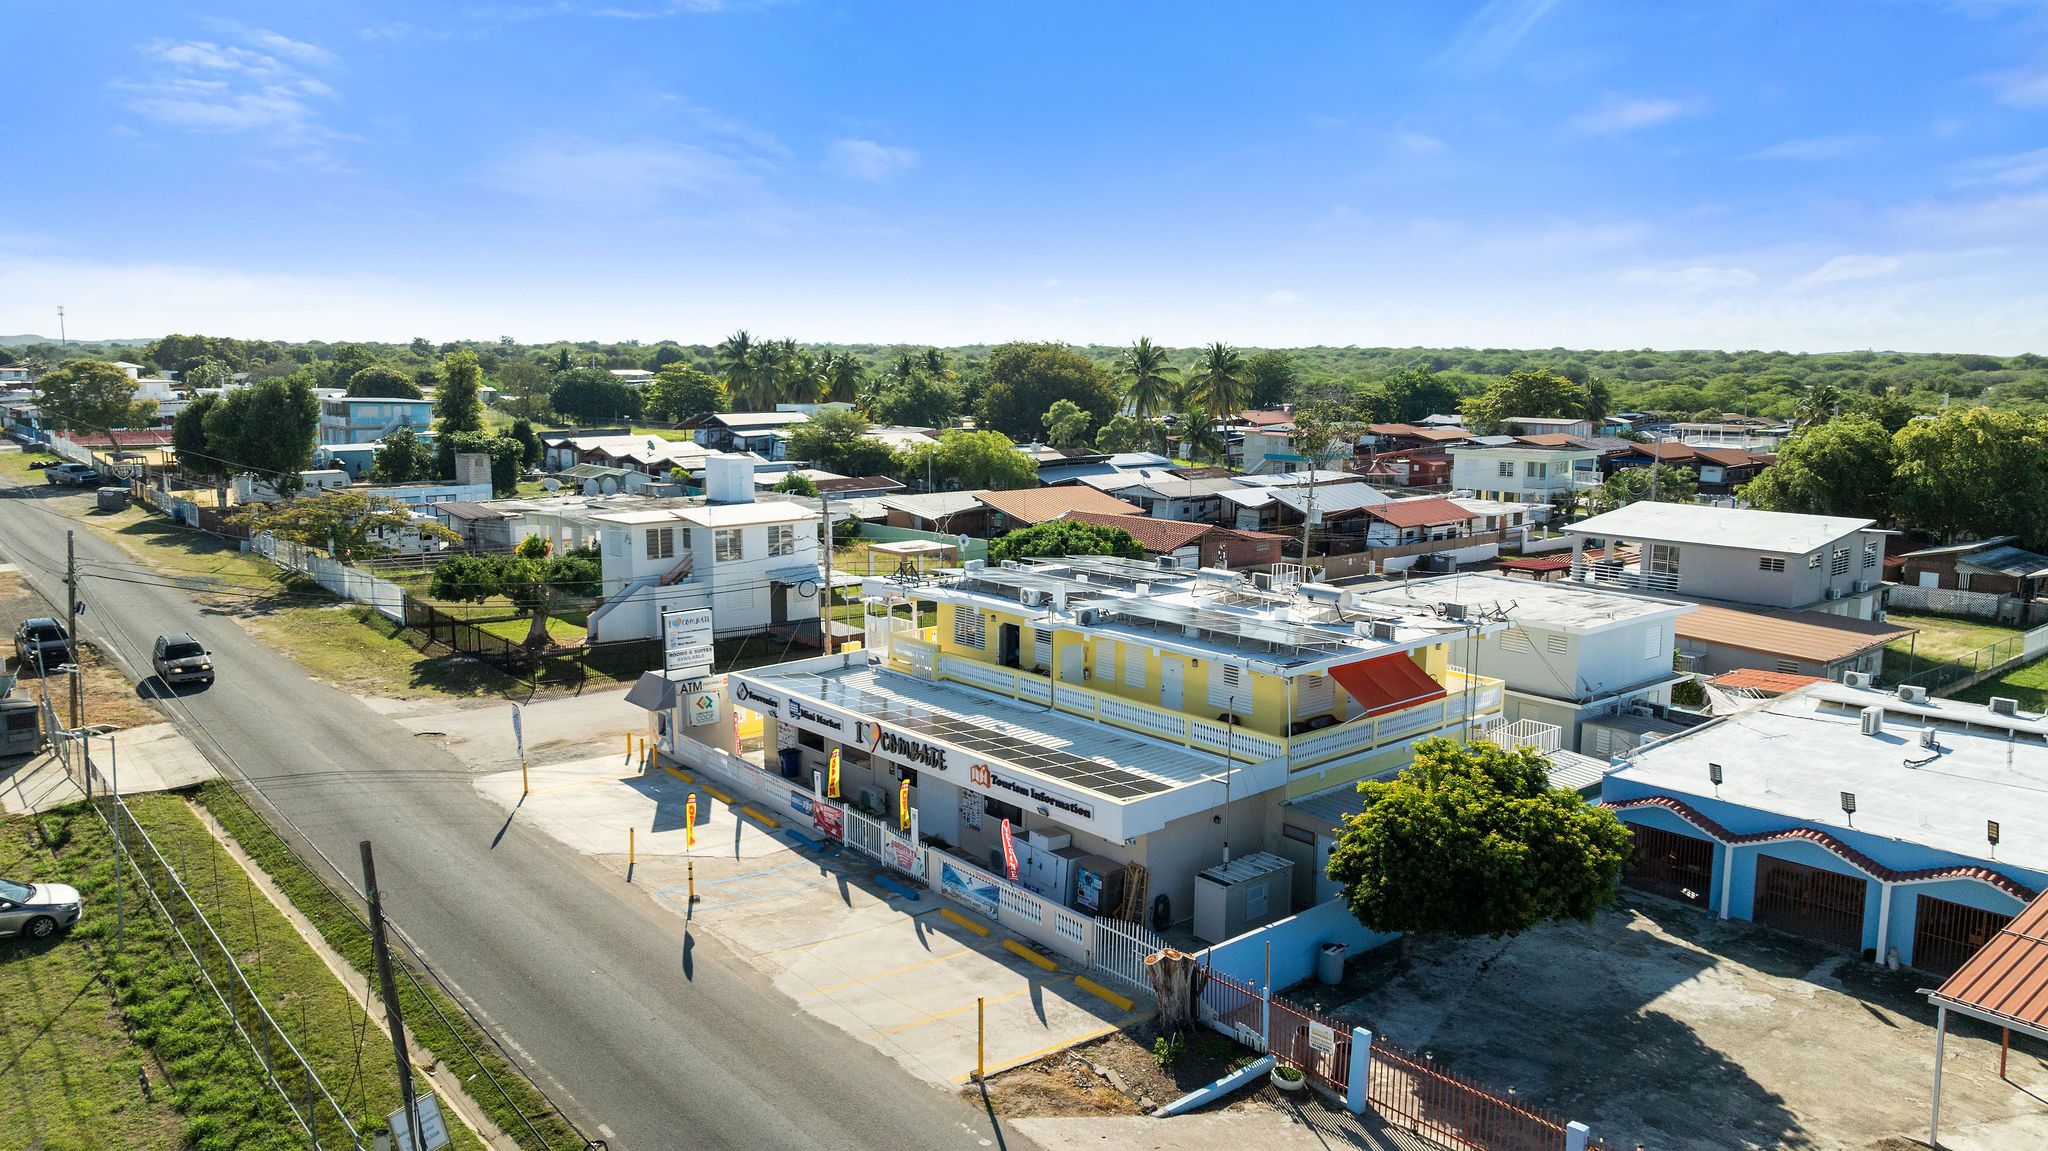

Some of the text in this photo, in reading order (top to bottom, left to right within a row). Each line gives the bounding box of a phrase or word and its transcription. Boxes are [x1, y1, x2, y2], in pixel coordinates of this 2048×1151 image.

[677, 654, 705, 662] AVAILABLE
[680, 681, 703, 694] ATM
[748, 690, 778, 708] Souvenirs
[800, 708, 842, 731] Mini Market
[855, 721, 948, 772] I COMBATE
[991, 775, 1092, 819] Tourism Information
[1003, 825, 1018, 878] WELCOME
